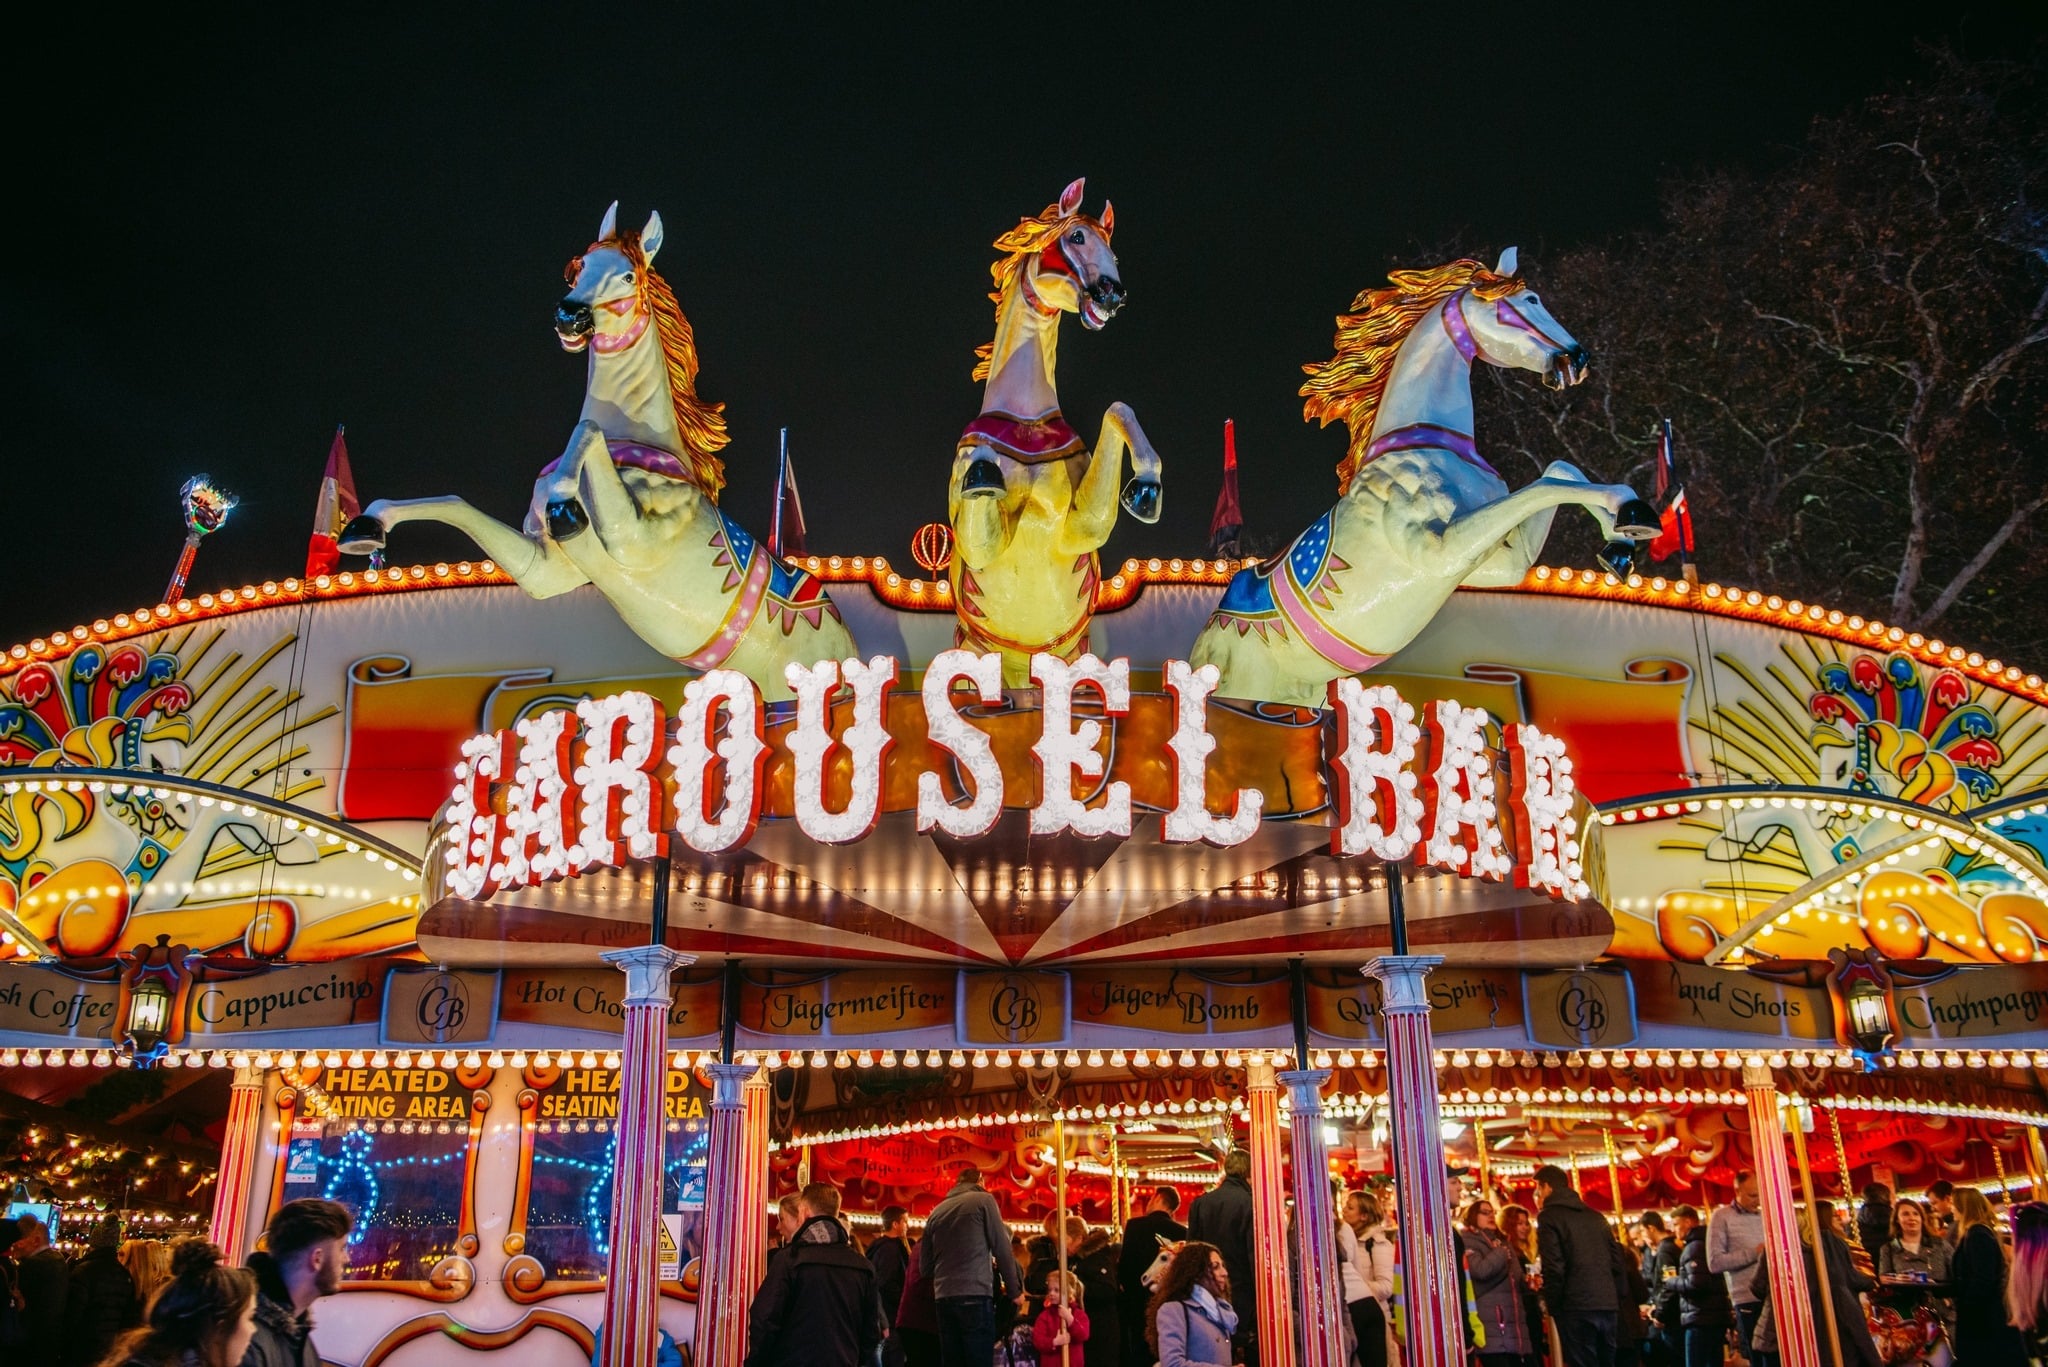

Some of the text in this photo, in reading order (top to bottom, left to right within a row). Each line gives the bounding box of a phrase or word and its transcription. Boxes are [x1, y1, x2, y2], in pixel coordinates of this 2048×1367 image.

[446, 649, 1590, 903] CAROUSEL BAR
[28, 989, 113, 1028] Coffee
[197, 974, 373, 1028] Cappuccino
[517, 981, 567, 1003] Hot
[1088, 981, 1259, 1025] Jäger Bomb
[1431, 979, 1507, 1010] Spirits
[1679, 982, 1801, 1018] and Shots
[1901, 991, 2048, 1030] Champagn
[326, 1069, 449, 1092] HEATED
[405, 1096, 466, 1118] AREA
[541, 1095, 704, 1118] SEATIN REA
